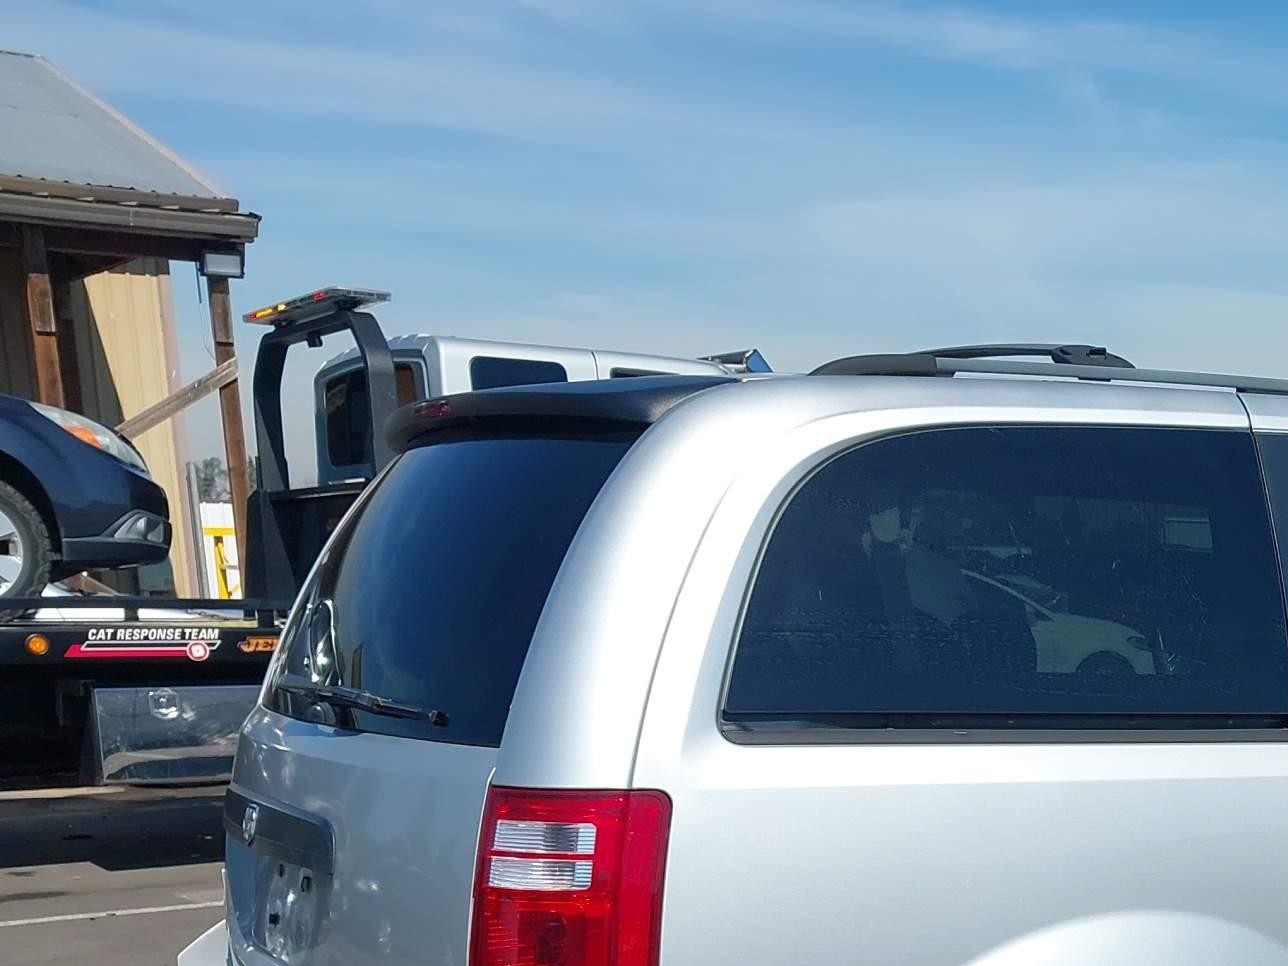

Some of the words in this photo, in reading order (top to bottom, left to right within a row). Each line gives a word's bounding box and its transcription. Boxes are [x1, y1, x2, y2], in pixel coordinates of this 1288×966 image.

[88, 628, 113, 641] CAT
[117, 628, 182, 641] RESPONSE
[184, 628, 219, 640] TEAM
